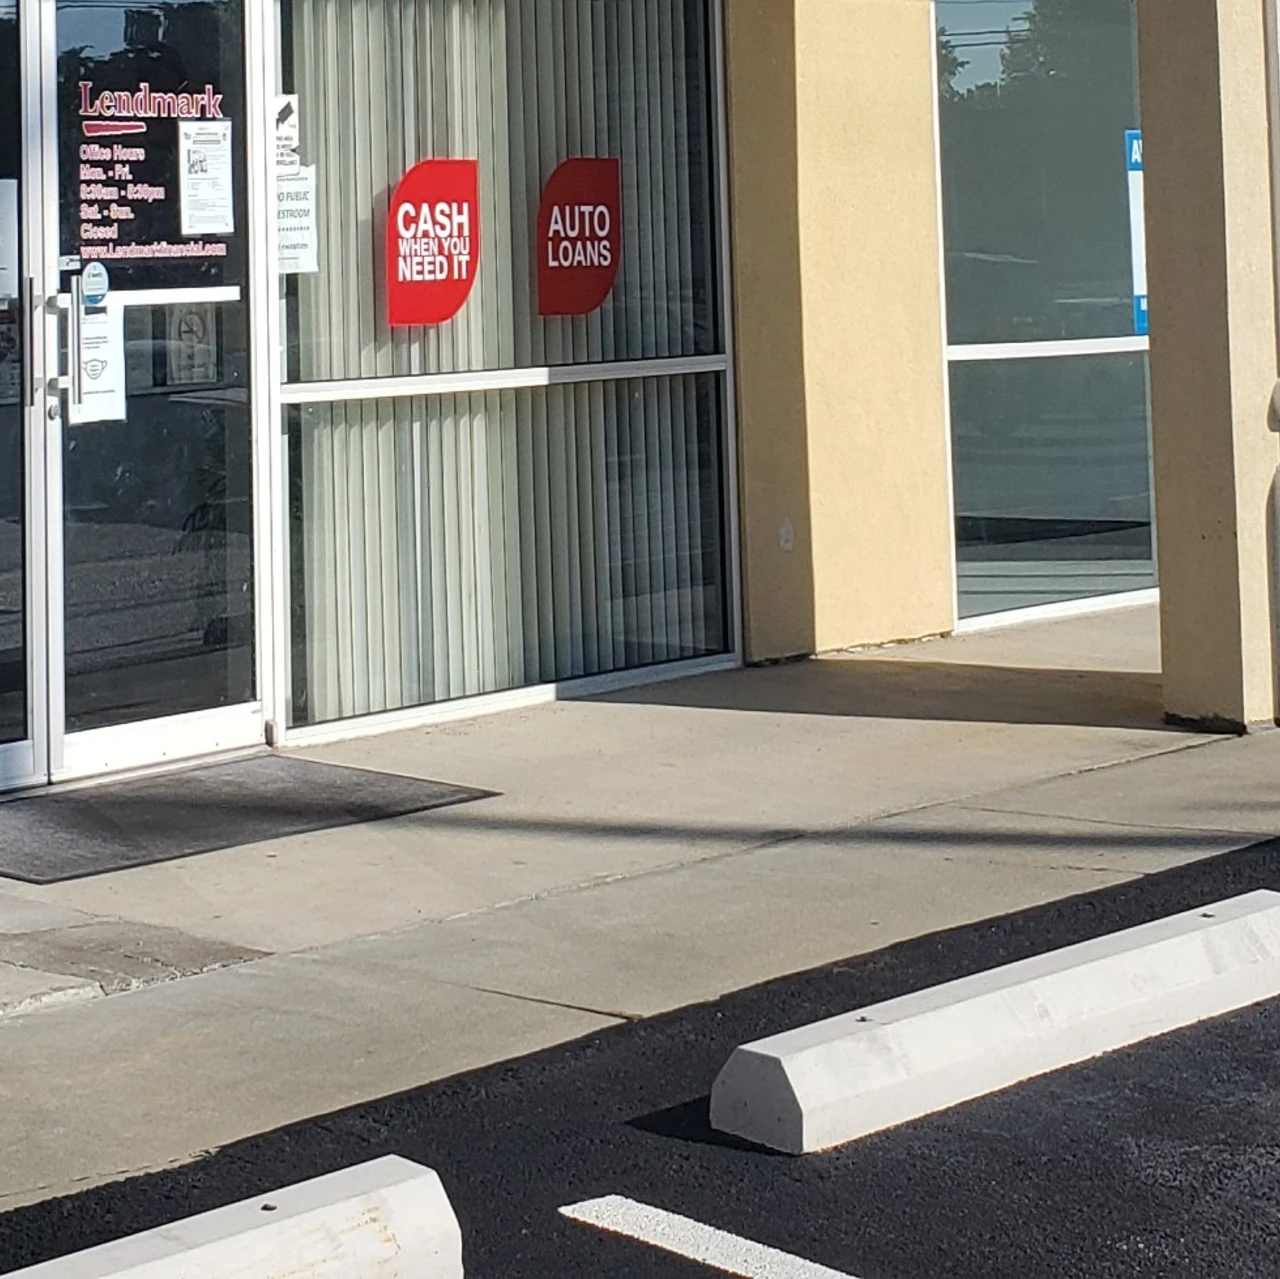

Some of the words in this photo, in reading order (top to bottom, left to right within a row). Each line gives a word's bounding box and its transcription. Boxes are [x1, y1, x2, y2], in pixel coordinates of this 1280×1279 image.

[79, 81, 224, 118] Lendmark
[79, 144, 111, 160] Office
[113, 144, 146, 160] Hours
[79, 164, 106, 180] Mon.
[114, 164, 133, 180] Fri.
[79, 203, 102, 220] Sat.
[109, 203, 135, 219] Sun.
[277, 209, 310, 219] ESTROOM
[397, 202, 469, 238] CASH
[548, 205, 610, 238] AUTO
[80, 223, 118, 239] Closed
[398, 237, 438, 257] WHEN
[442, 237, 470, 256] YOU
[548, 240, 612, 267] LOANS
[398, 256, 449, 281] NEED
[453, 255, 470, 280] IT
